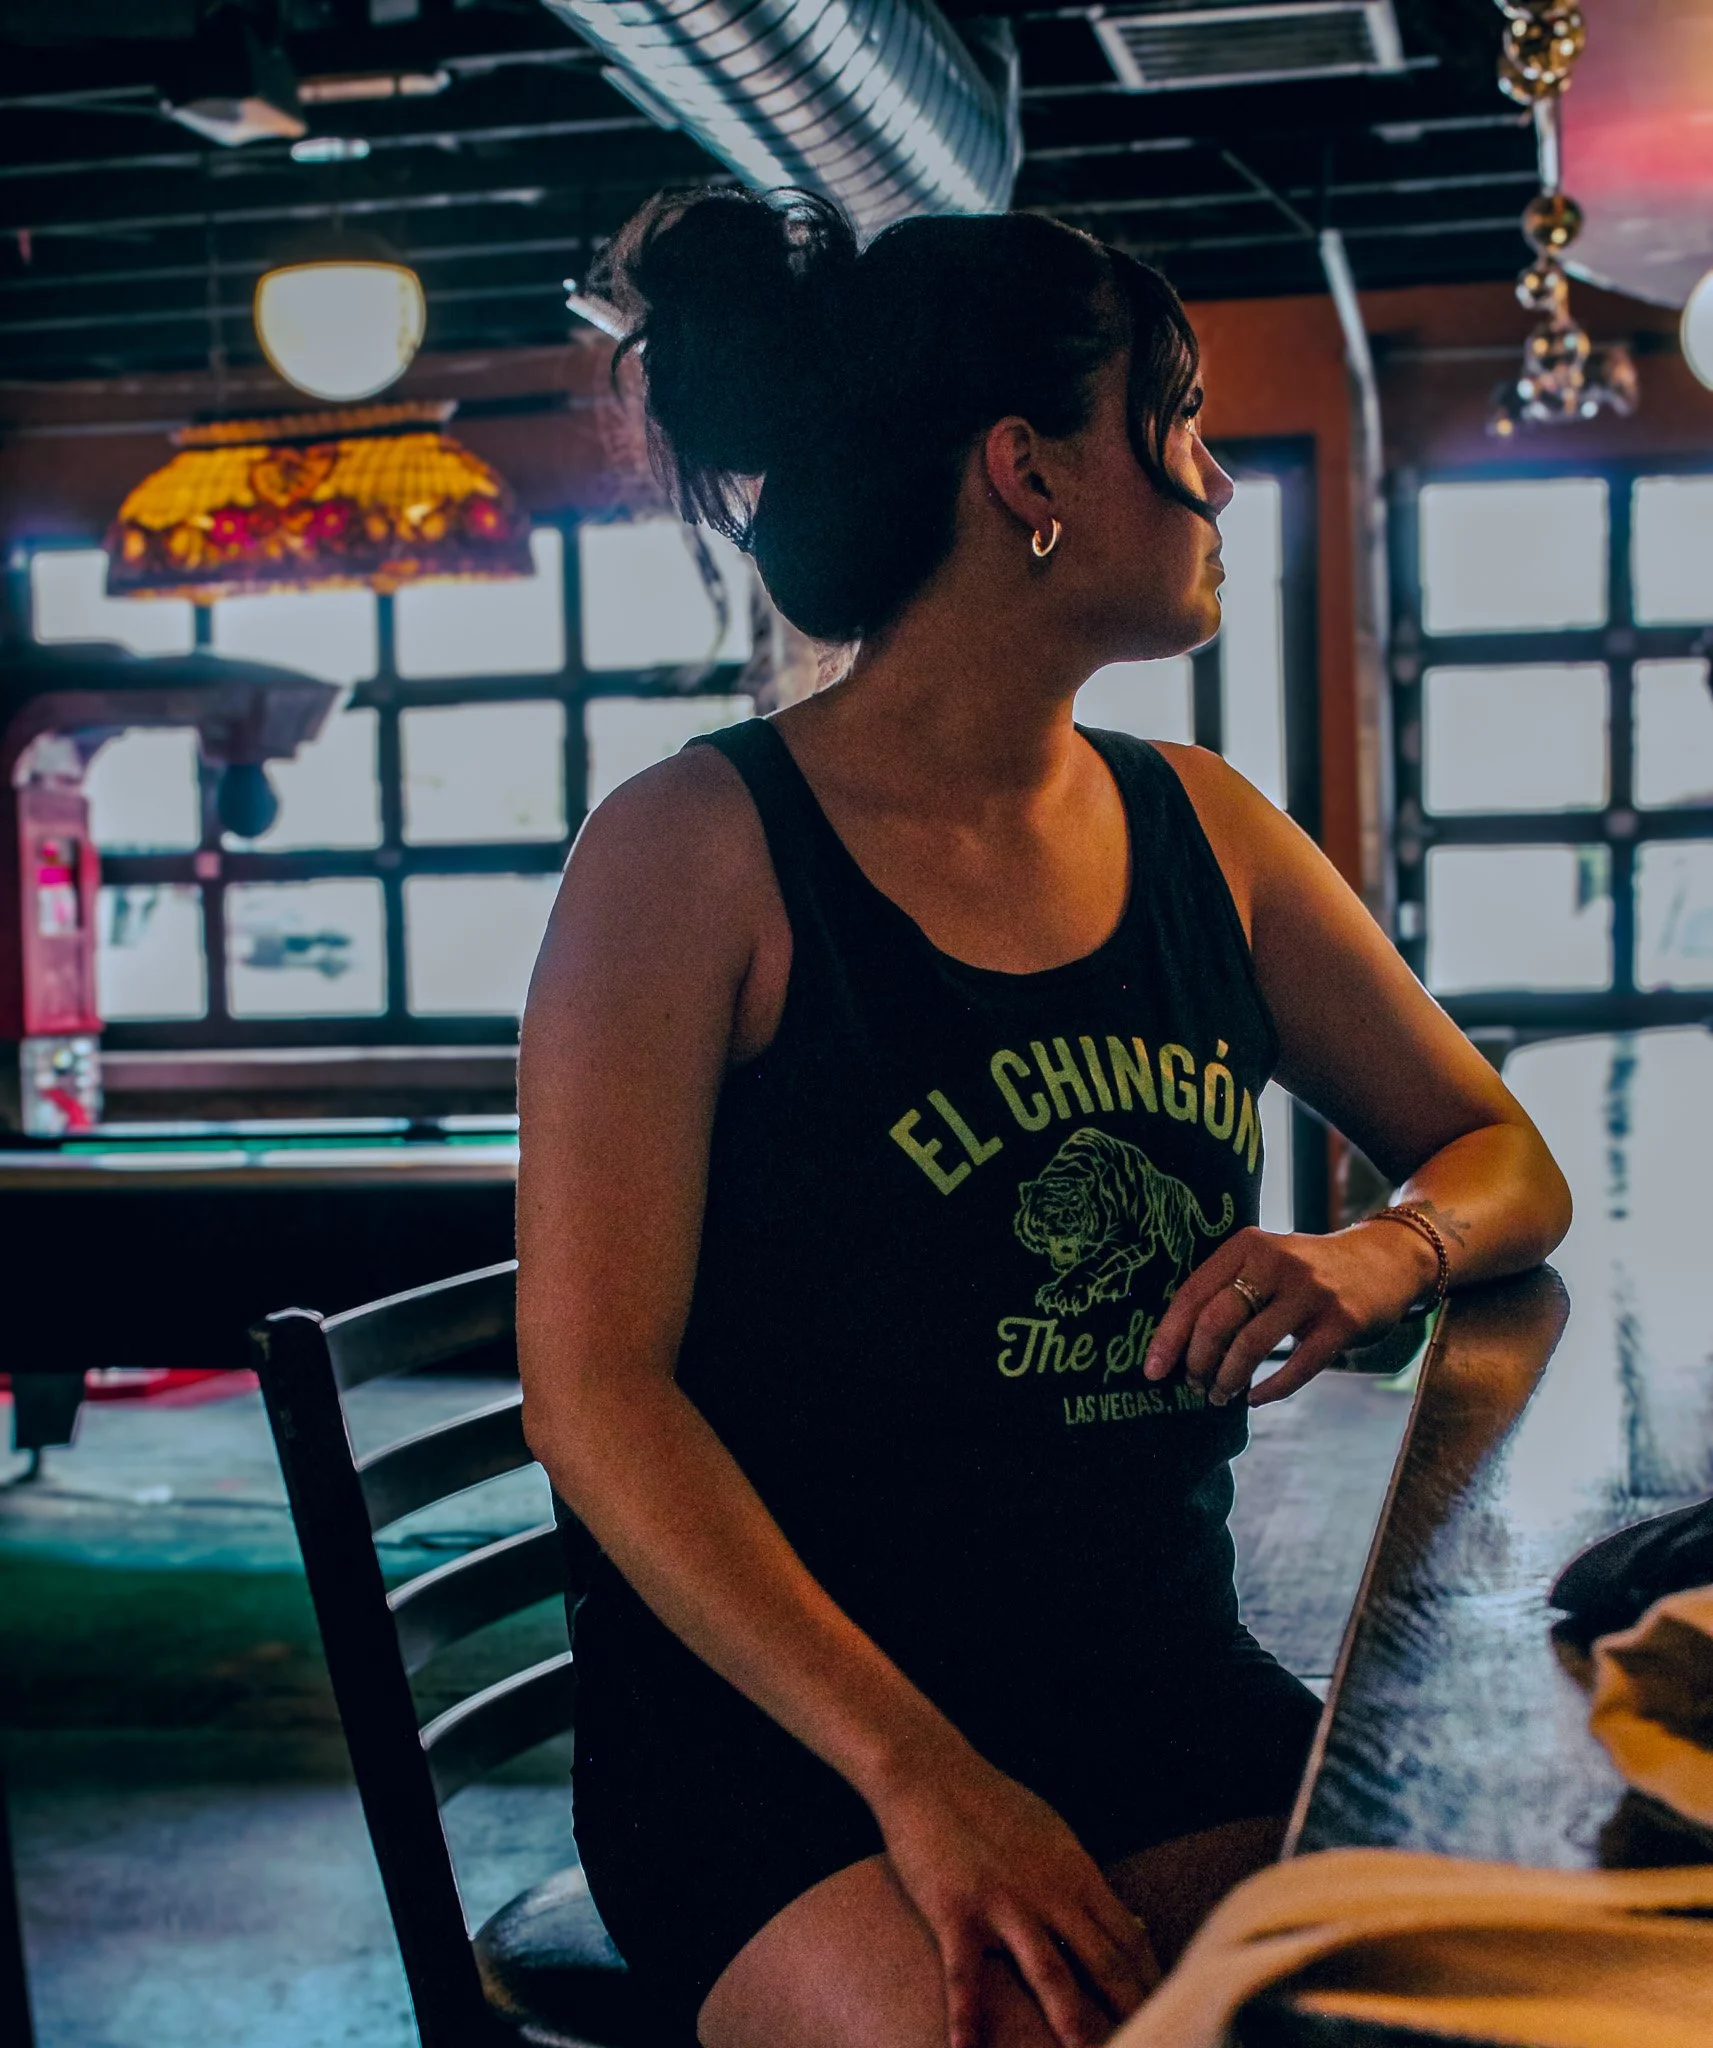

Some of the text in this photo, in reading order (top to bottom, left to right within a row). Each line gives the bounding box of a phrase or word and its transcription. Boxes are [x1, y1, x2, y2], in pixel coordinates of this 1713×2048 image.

[889, 1035, 1261, 1196] EL CHINGÓN
[997, 1315, 1097, 1377] The
[1063, 1395, 1096, 1425] LAS
[1099, 1389, 1172, 1421] VEGAS,
